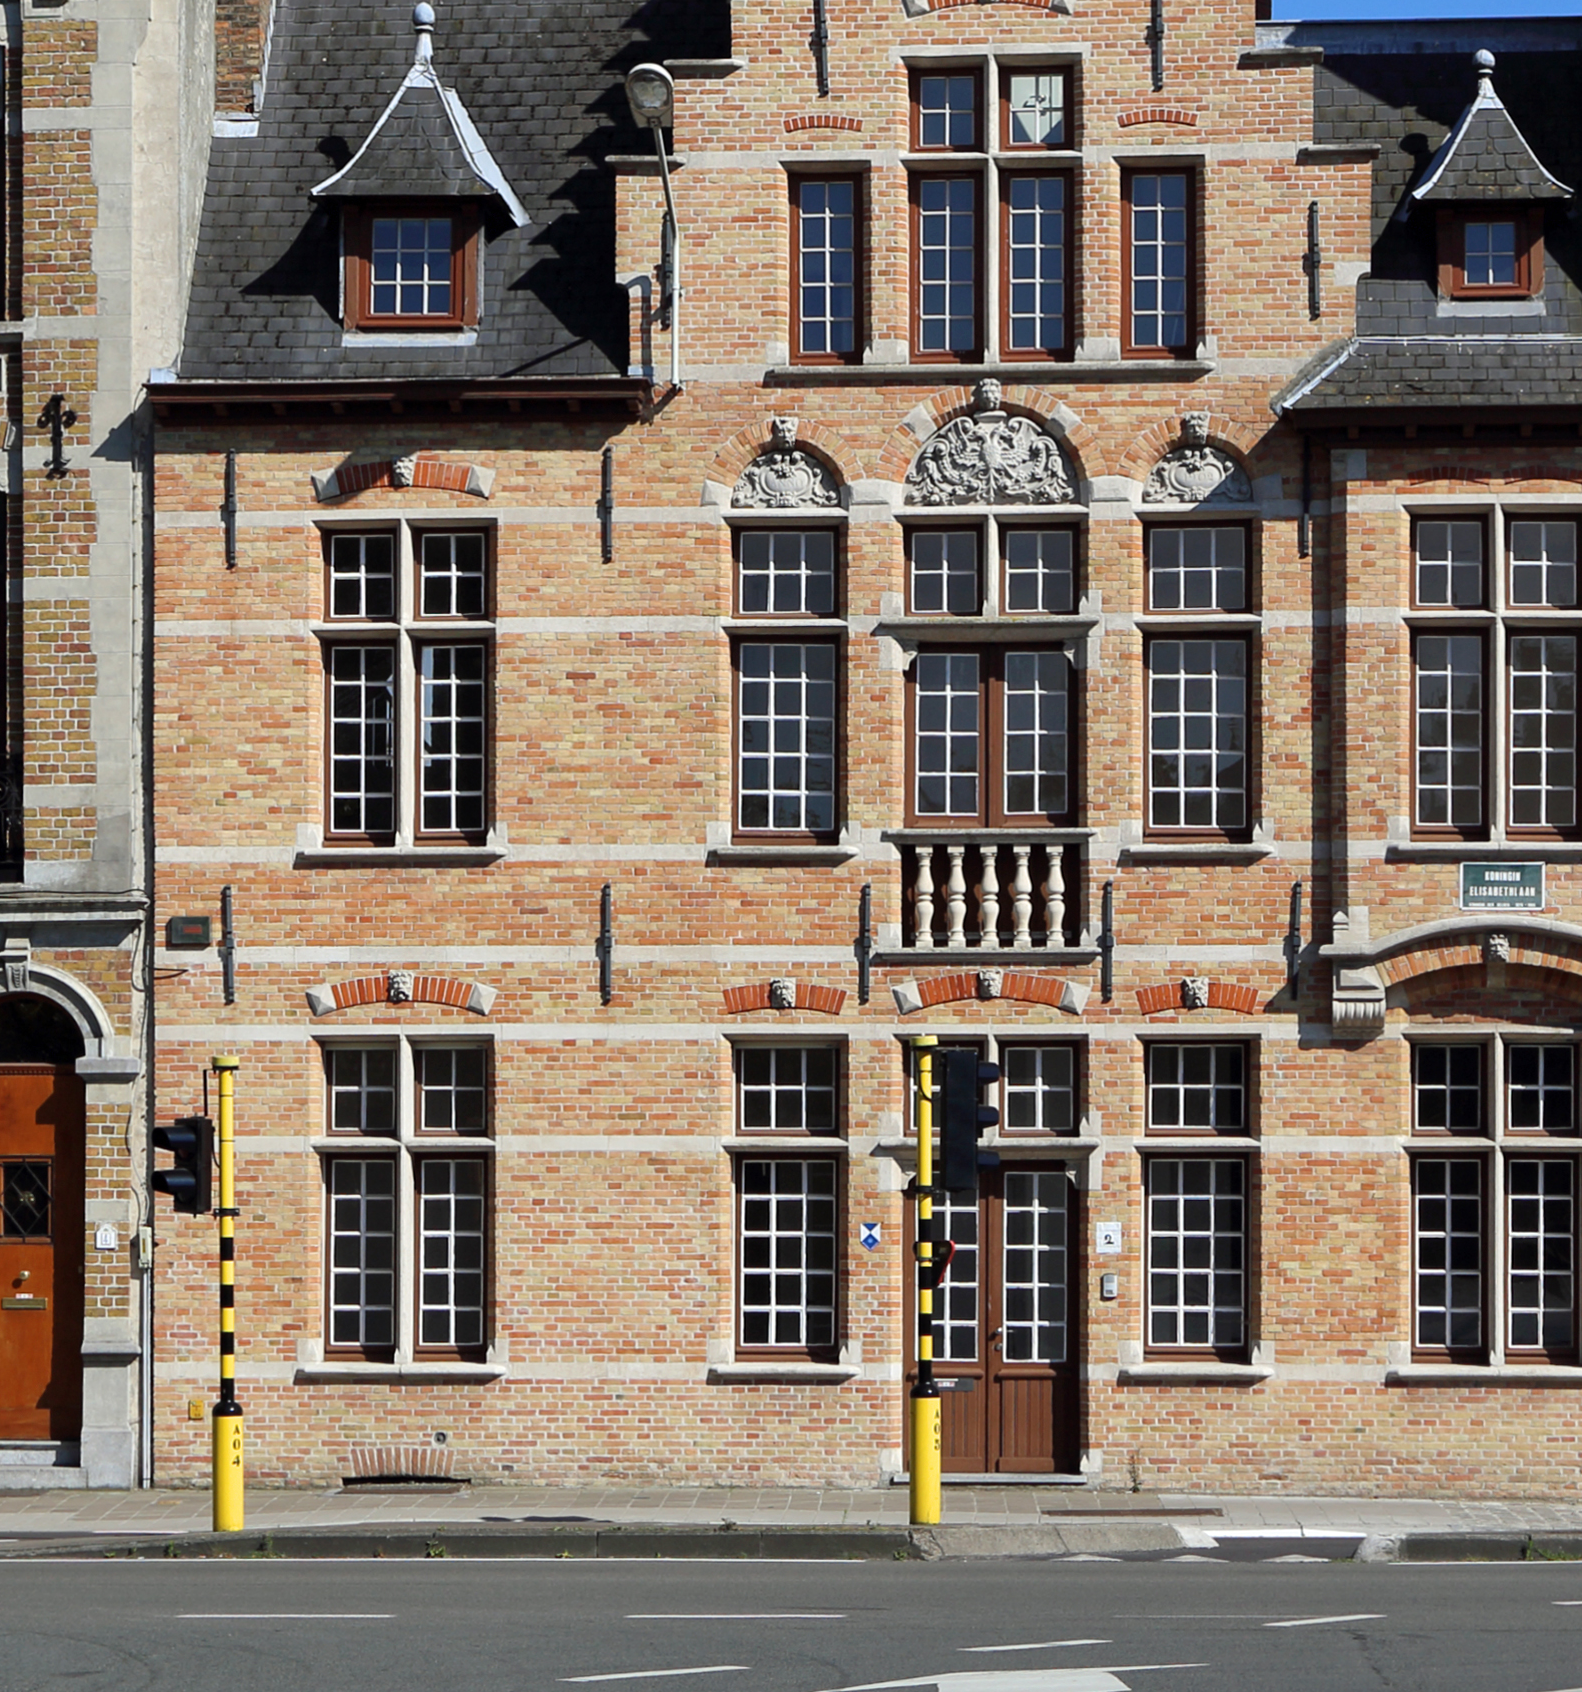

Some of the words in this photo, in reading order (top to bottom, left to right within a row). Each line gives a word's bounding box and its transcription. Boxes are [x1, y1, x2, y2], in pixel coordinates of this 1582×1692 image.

[1484, 871, 1521, 882] KONINGIN
[1469, 886, 1536, 897] ELISABETHLAAN
[1104, 1234, 1115, 1245] 2
[232, 1424, 241, 1467] A04
